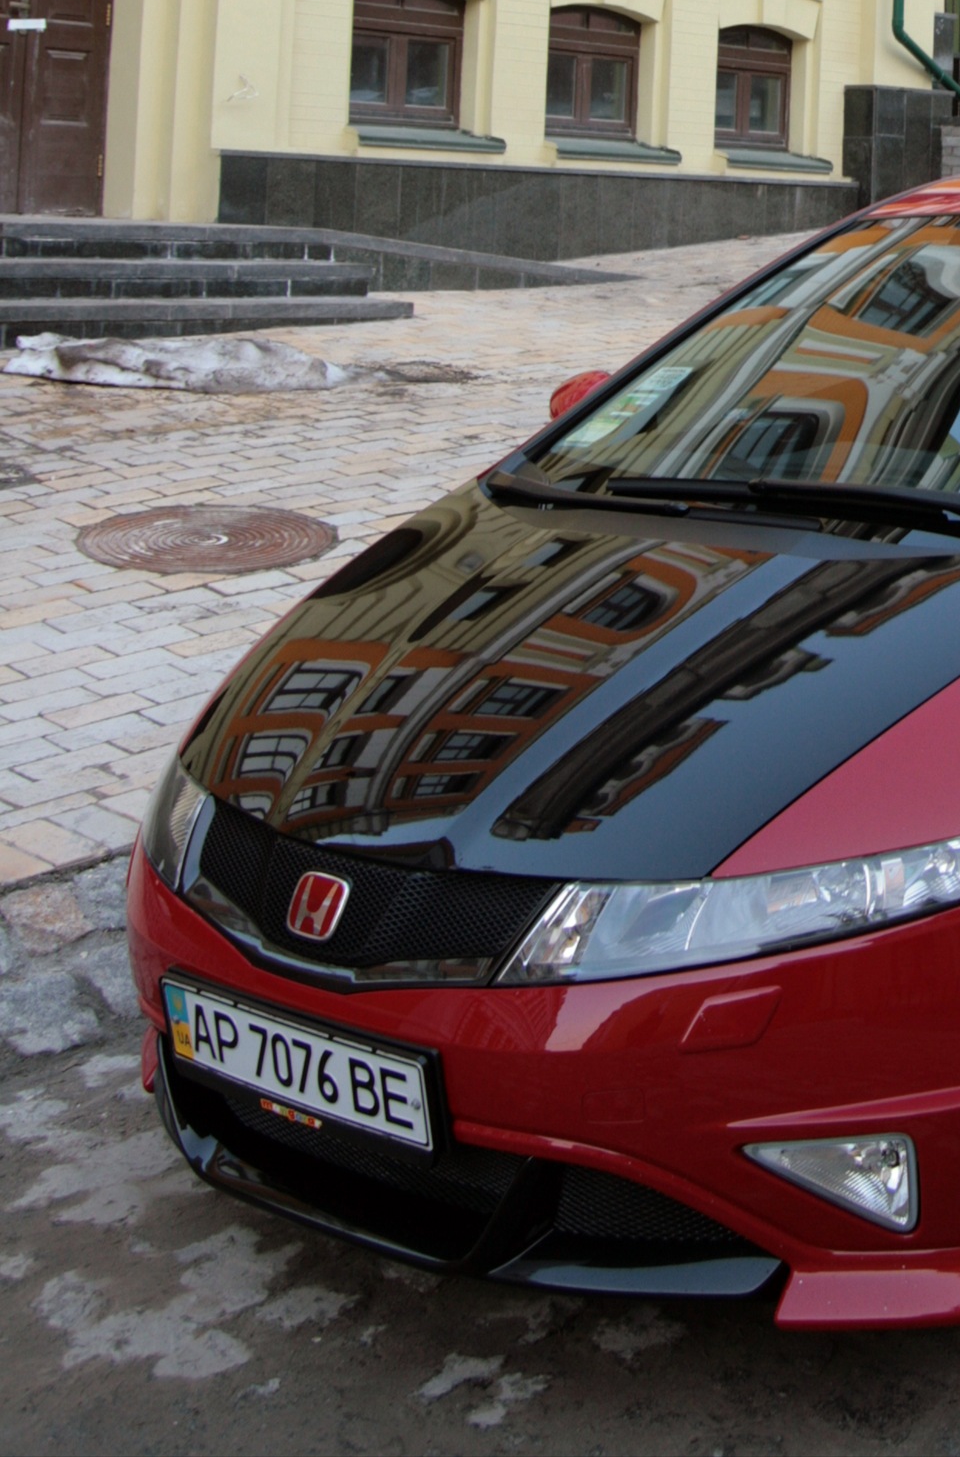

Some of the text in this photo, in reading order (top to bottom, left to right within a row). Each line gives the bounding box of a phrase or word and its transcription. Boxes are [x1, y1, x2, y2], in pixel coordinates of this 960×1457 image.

[195, 1004, 239, 1063] AP
[248, 1023, 339, 1104] 7076
[348, 1057, 414, 1130] BE
